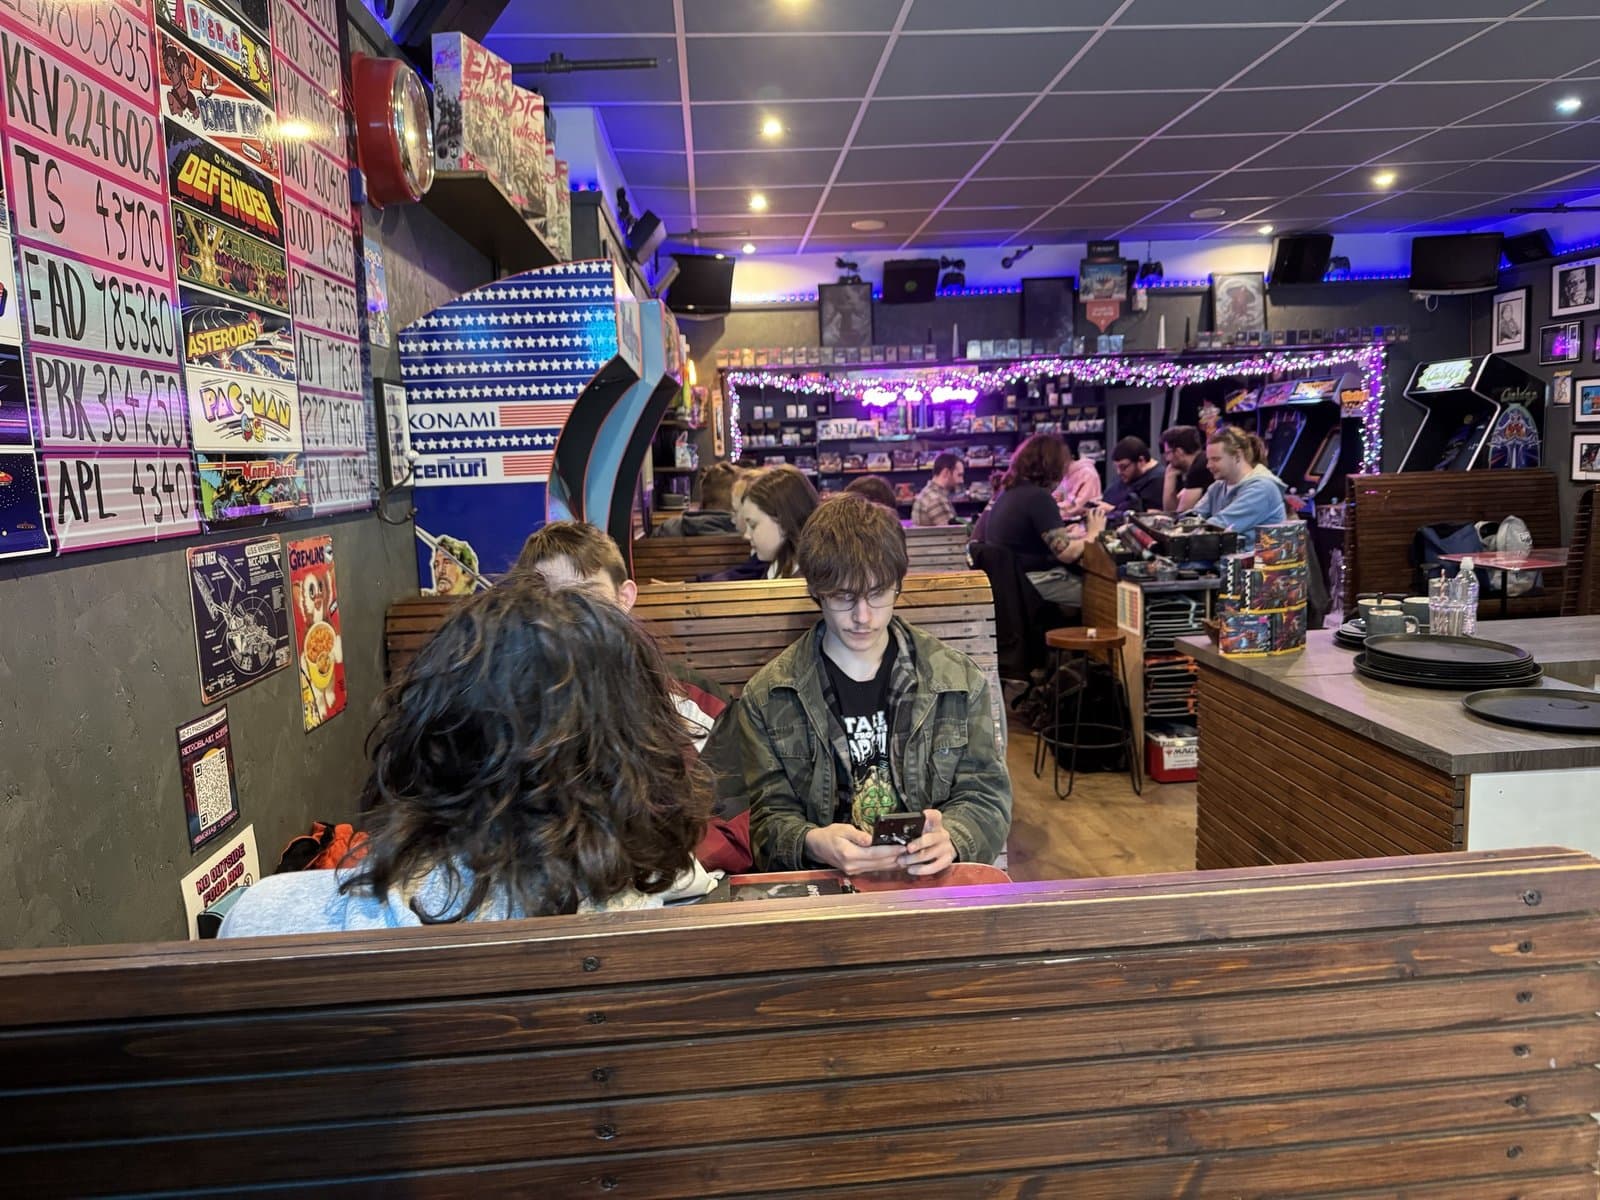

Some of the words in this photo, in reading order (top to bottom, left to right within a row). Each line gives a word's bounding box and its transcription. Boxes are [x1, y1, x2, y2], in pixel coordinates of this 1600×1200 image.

[1, 31, 60, 137] KEV
[63, 74, 160, 185] 224602
[14, 145, 66, 234] TS
[95, 179, 165, 273] 43700
[177, 152, 280, 238] DEFENDER
[24, 251, 87, 342] EAD
[91, 272, 174, 358] 785360
[291, 267, 316, 320] PAT
[187, 320, 257, 359] ASTEROIDS
[298, 330, 323, 385] AJT
[35, 356, 97, 443] PBK
[92, 363, 184, 449] 364250
[200, 382, 291, 432] PAC-MAN
[409, 411, 496, 430] KONAMI
[57, 459, 118, 525] APL
[132, 458, 189, 526] 4340
[289, 545, 325, 571] GREMLINS
[196, 873, 211, 896] NO
[209, 842, 246, 878] OUTSIDE
[203, 877, 228, 909] FOOD
[226, 861, 245, 887] AND
